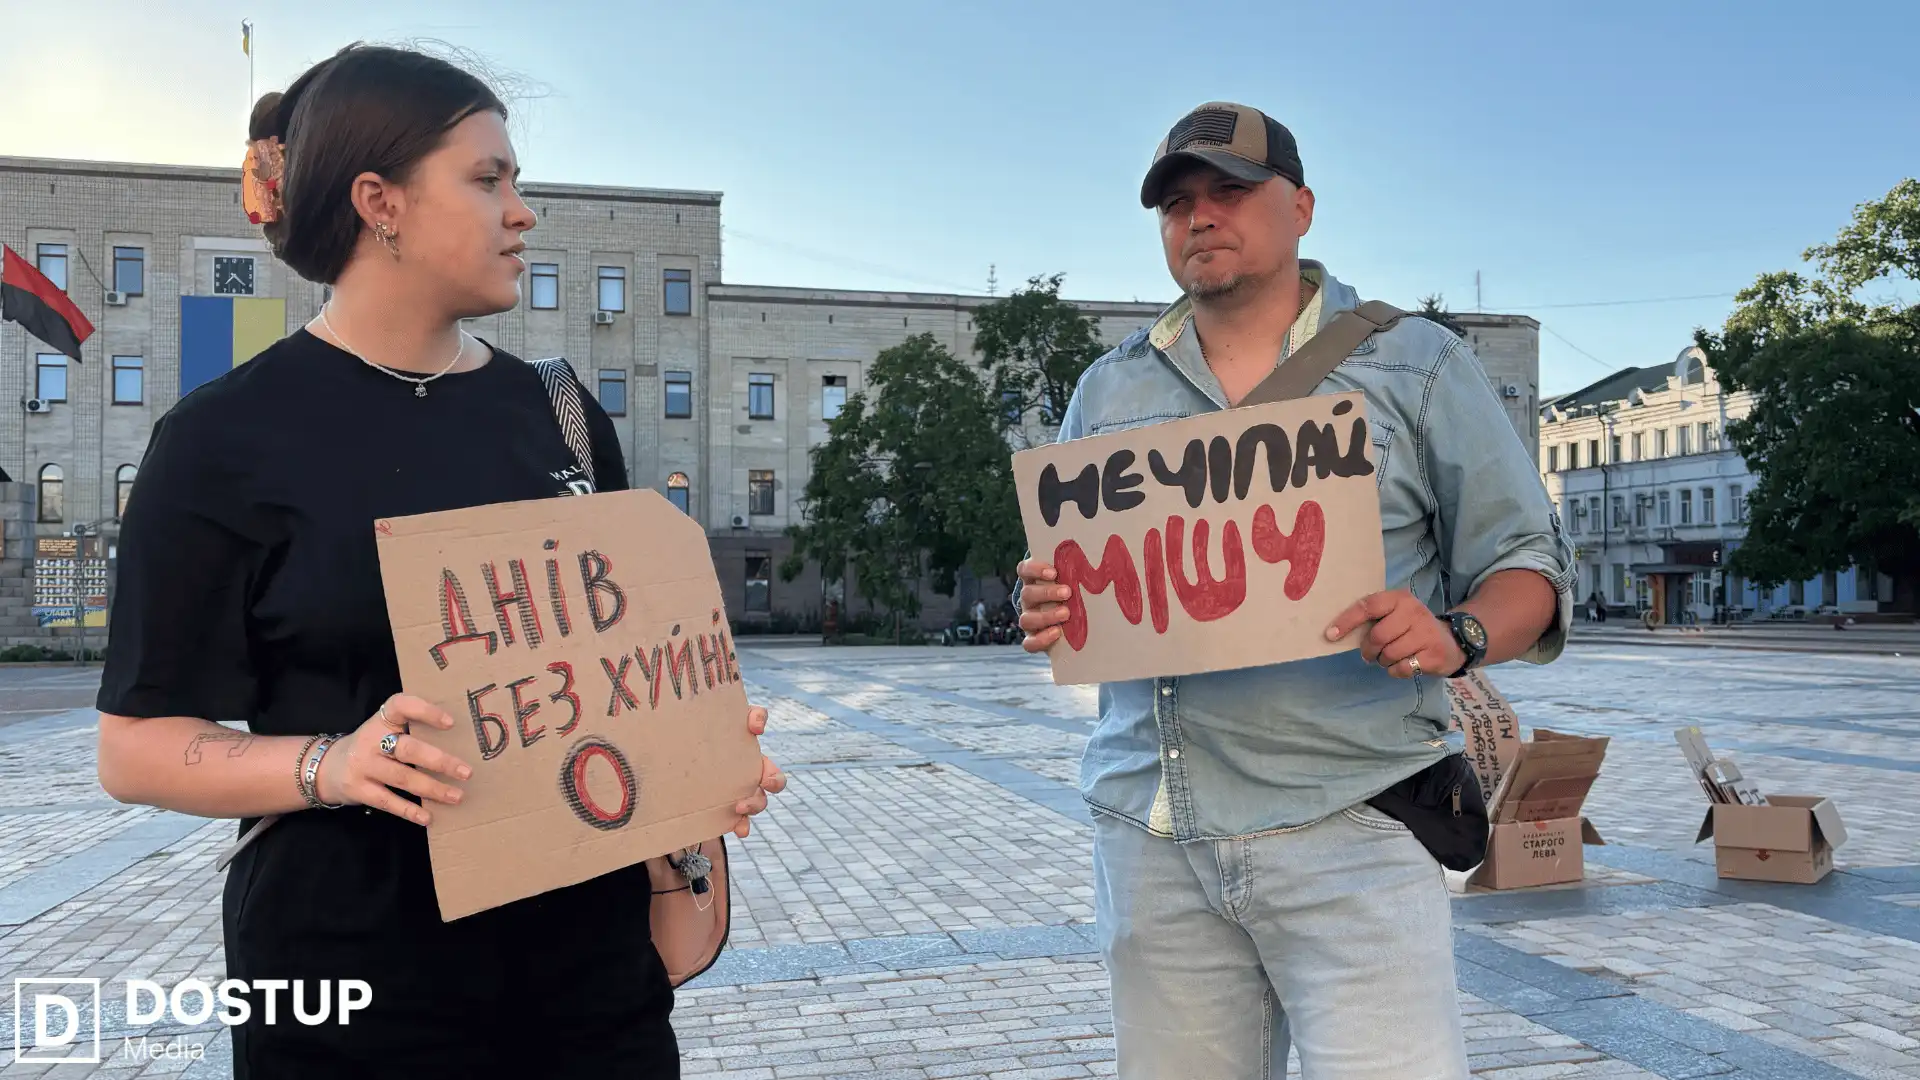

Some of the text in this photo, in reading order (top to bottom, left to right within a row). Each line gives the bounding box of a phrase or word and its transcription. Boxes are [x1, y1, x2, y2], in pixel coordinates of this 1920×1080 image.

[429, 539, 627, 671] ДНІВ
[467, 661, 583, 760] БЕЗ
[1523, 837, 1565, 849] СТАРОГО
[1532, 849, 1556, 859] ЛЕВА
